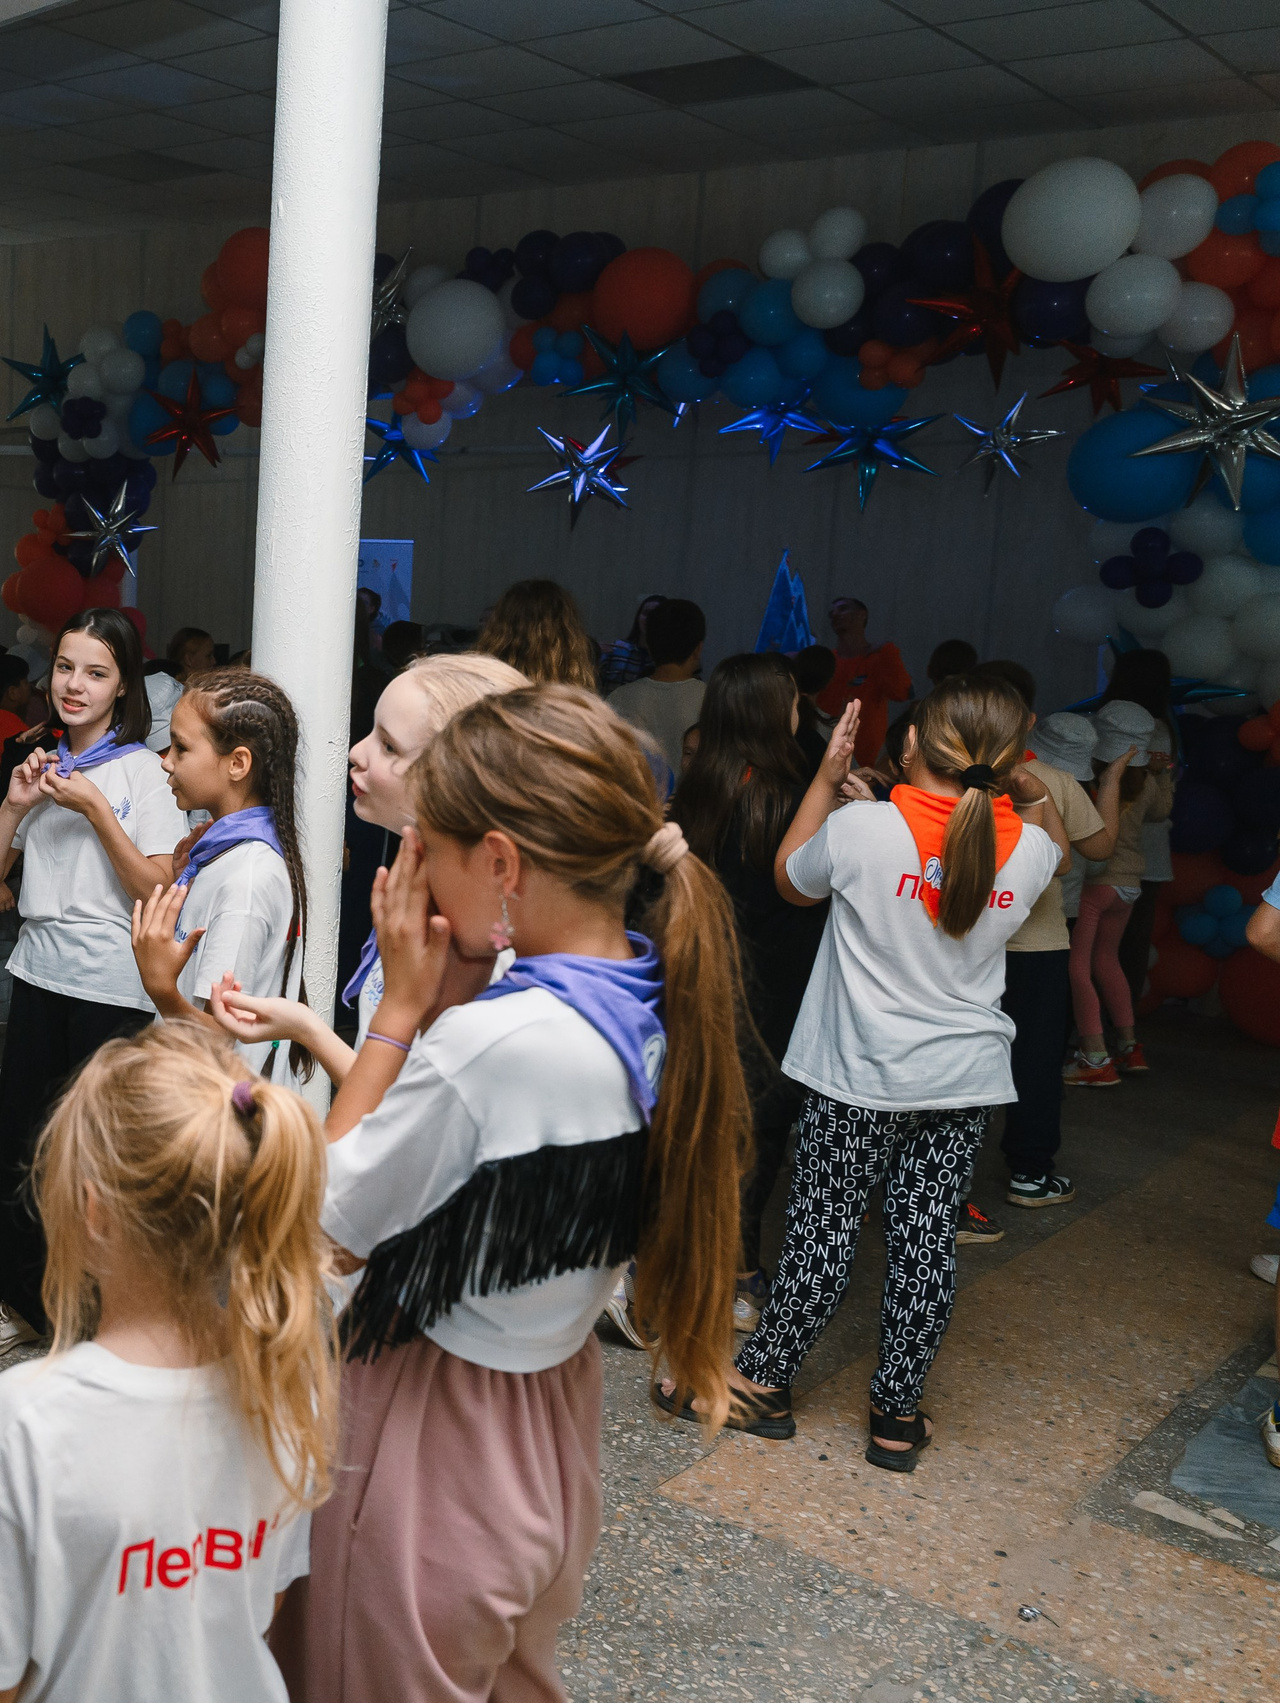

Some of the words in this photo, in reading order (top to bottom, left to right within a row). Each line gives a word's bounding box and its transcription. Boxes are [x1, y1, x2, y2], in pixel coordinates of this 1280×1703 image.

[817, 1098, 836, 1116] ME
[847, 1107, 877, 1122] ON
[809, 1125, 834, 1147] ICE
[845, 1135, 872, 1149] ME
[946, 1138, 976, 1159] ICE
[808, 1156, 832, 1174] ON
[844, 1162, 874, 1177] ICE
[900, 1153, 927, 1176] ME
[937, 1169, 964, 1189] ON
[808, 1184, 832, 1200] ME
[803, 1211, 830, 1230] ICE
[928, 1200, 953, 1220] ME
[804, 1240, 829, 1260] ON
[919, 1230, 947, 1253] ICE
[796, 1267, 824, 1290] ME
[916, 1265, 944, 1286] ON
[782, 1292, 816, 1315] ICE
[909, 1295, 939, 1316] ME
[776, 1320, 804, 1339] ON
[896, 1323, 929, 1345] ICE
[890, 1352, 916, 1371] ON
